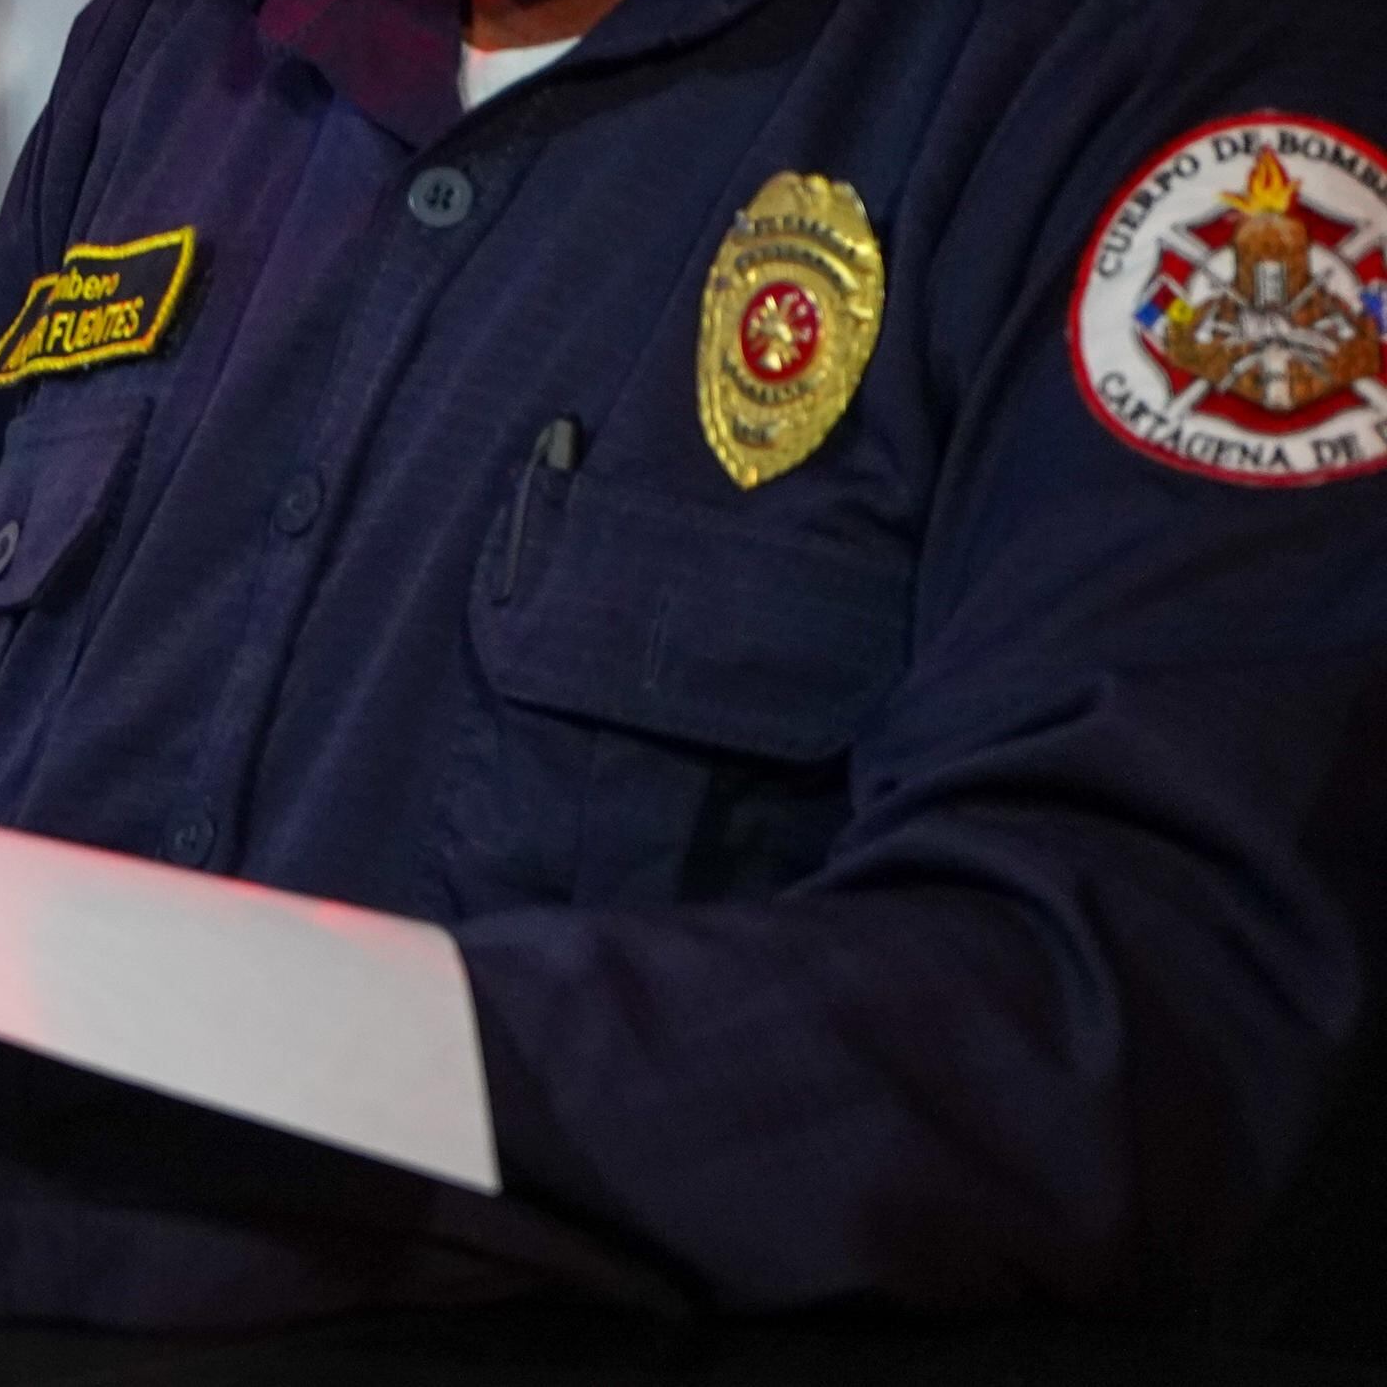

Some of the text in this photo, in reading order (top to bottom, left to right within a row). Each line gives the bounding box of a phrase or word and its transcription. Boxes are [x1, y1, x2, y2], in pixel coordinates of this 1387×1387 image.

[1097, 154, 1200, 279] CUERPO
[1212, 130, 1263, 162] DE
[1099, 371, 1292, 470] CARTAGENA
[1312, 432, 1362, 464] DE
